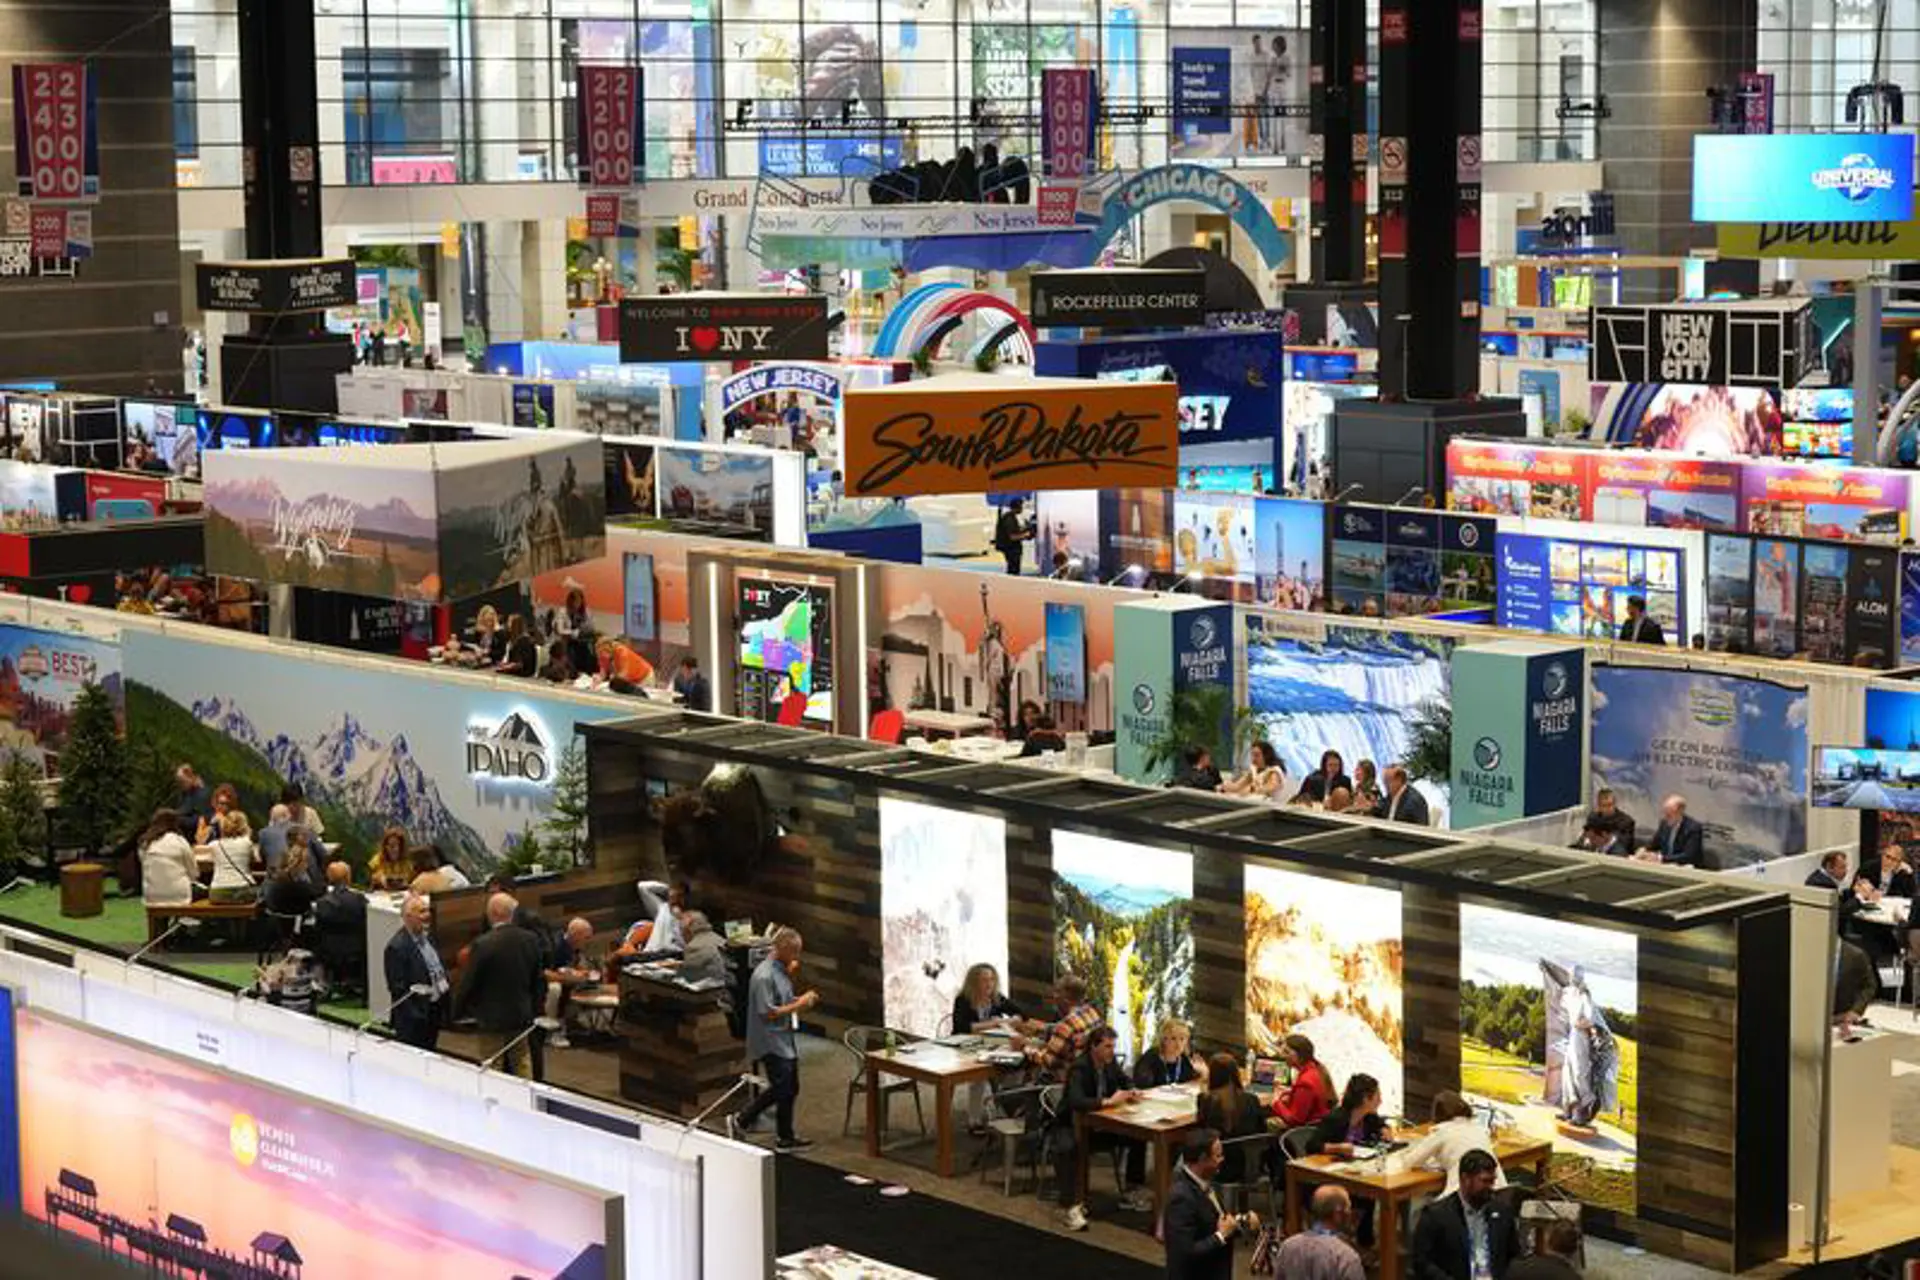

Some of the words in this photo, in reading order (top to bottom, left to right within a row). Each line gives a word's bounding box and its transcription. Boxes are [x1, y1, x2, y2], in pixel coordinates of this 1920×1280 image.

[1129, 168, 1238, 208] CHICAGO
[1811, 167, 1895, 190] UNIVERSAL
[694, 187, 748, 208] Grand
[1052, 294, 1146, 309] ROCKEFELLER
[1147, 292, 1199, 308] CENTER
[1661, 314, 1714, 337] NEW
[719, 326, 774, 351] NY
[1662, 335, 1711, 358] YORK
[1661, 358, 1711, 380] CITY
[727, 371, 769, 402] NEW
[770, 368, 836, 394] JERSEY
[856, 410, 1006, 493] South
[981, 401, 1170, 472] Dakota
[1180, 645, 1227, 669] NIAGARA
[1188, 663, 1219, 684] FALLS
[1533, 696, 1577, 720] NIAGARA
[1540, 715, 1571, 735] FALLS
[1651, 738, 1679, 752] GET
[1680, 741, 1697, 754] ON
[466, 742, 546, 782] IDAHO
[1653, 751, 1714, 770] ELECTRIC
[1459, 769, 1514, 792] NIAGARA
[1468, 787, 1506, 808] FALLS
